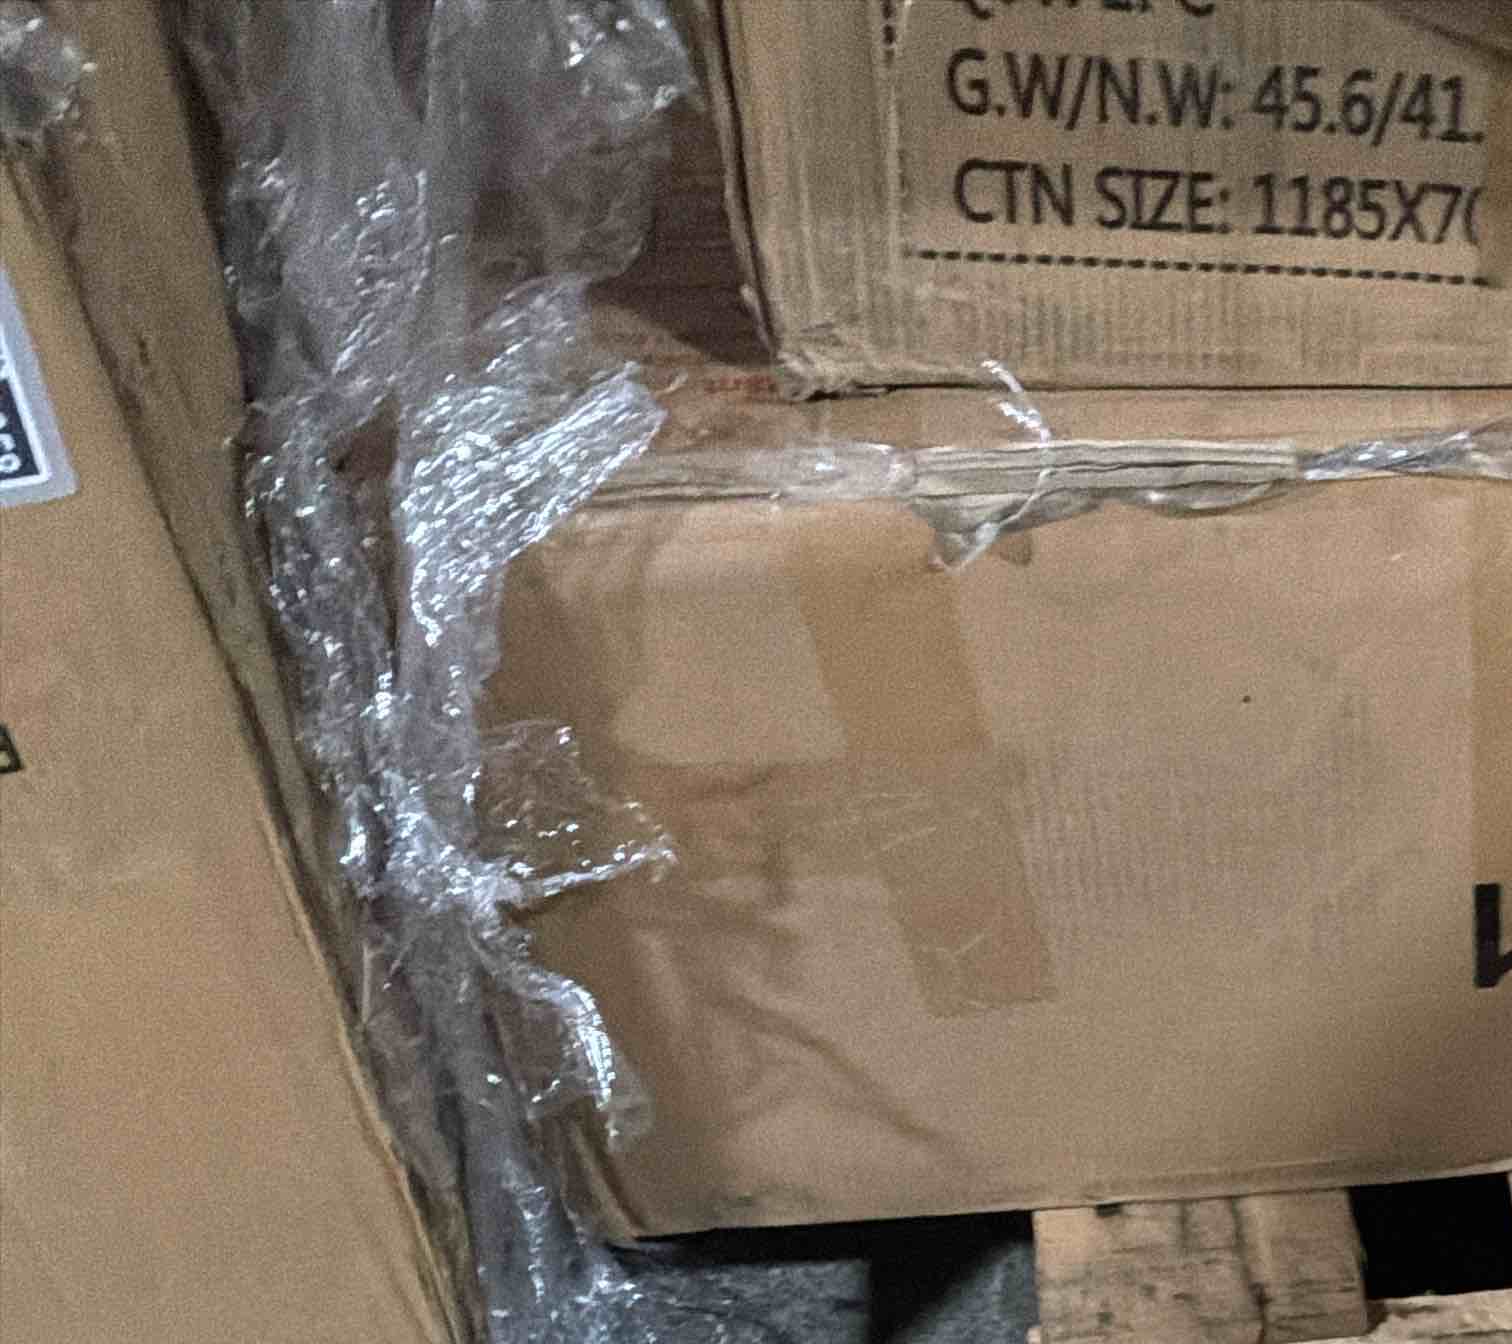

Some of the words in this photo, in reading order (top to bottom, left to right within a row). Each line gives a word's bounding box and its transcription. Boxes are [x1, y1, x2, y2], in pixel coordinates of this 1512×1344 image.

[946, 47, 1235, 131] G.W/N.W:
[953, 158, 1076, 227] CTN
[1095, 166, 1233, 234] SIZE:
